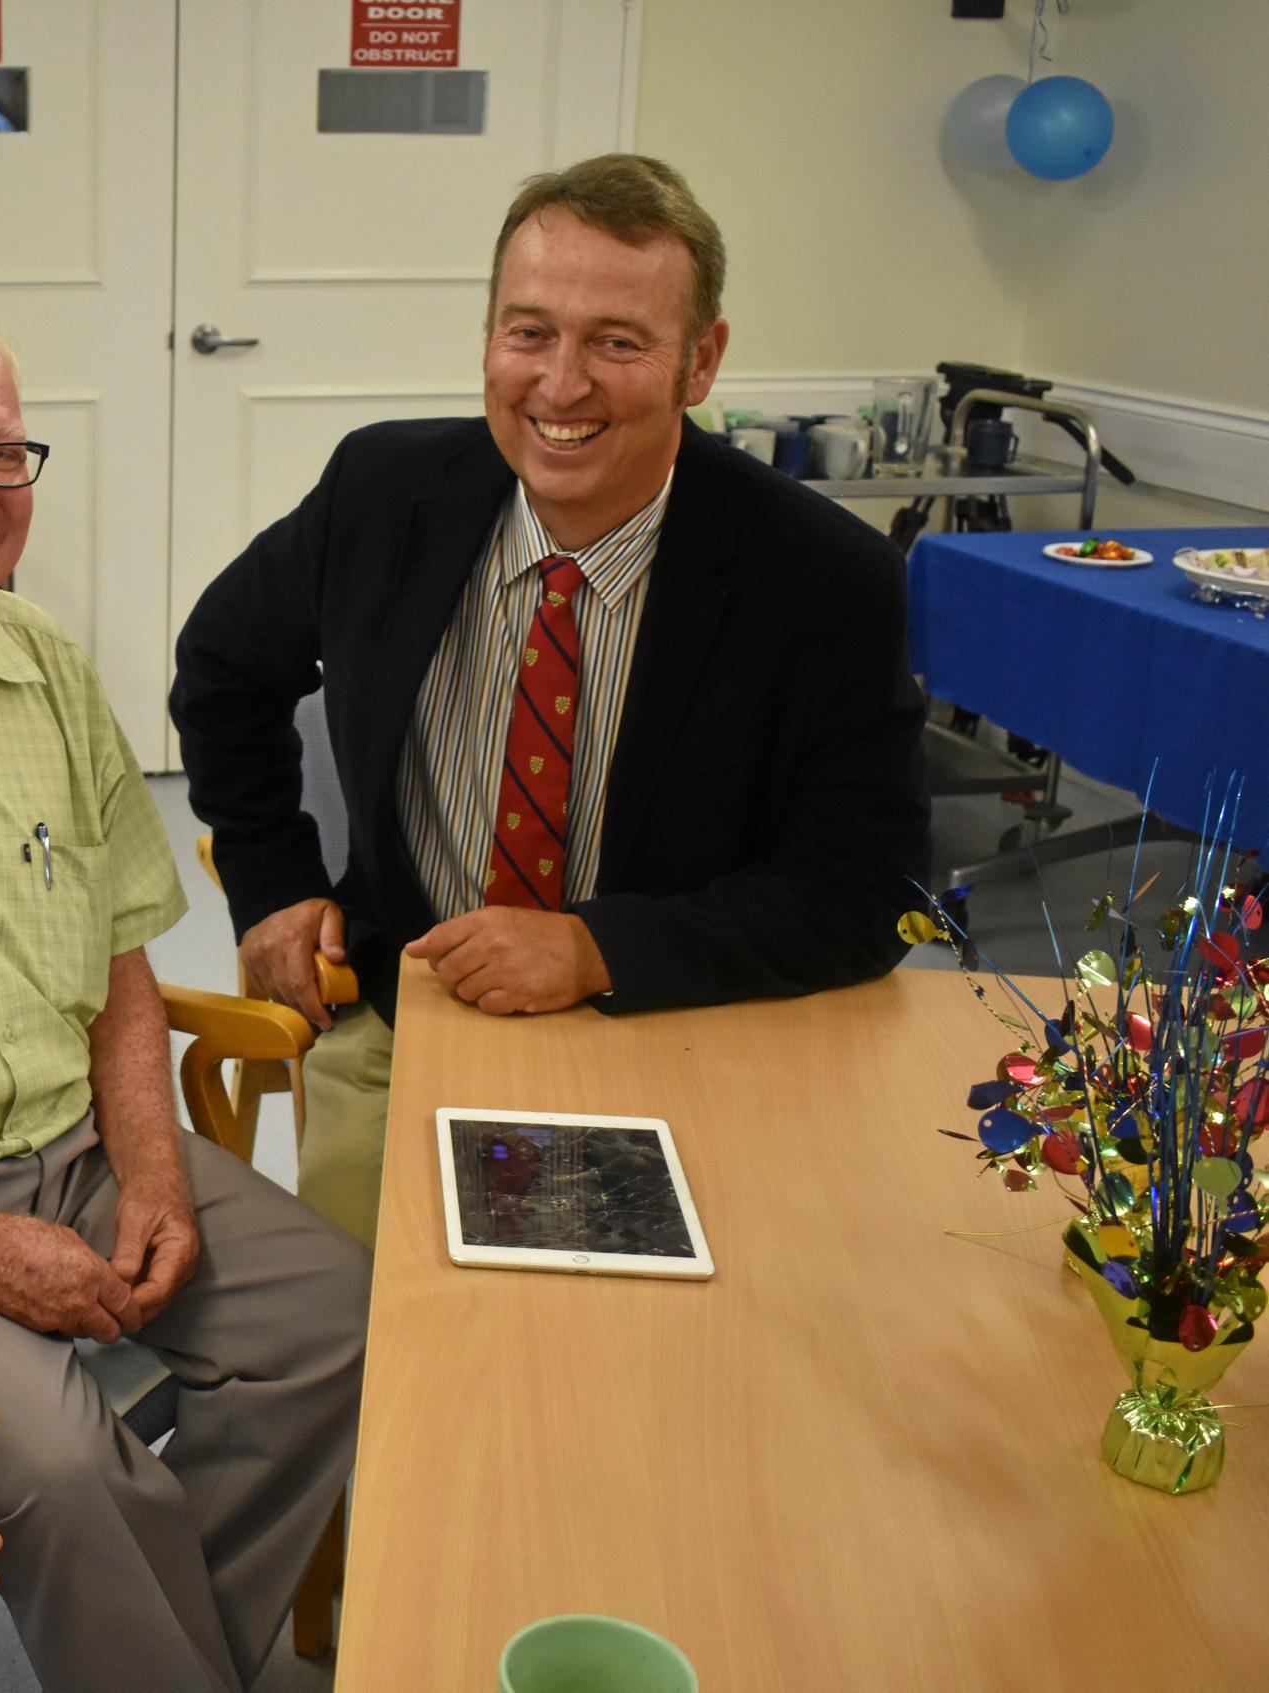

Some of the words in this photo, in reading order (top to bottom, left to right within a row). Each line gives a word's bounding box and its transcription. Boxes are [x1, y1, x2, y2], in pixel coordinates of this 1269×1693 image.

[367, 6, 444, 20] DOOR
[369, 31, 398, 44] DO
[401, 31, 441, 44] NOT
[353, 48, 455, 61] OBSTRUCT
